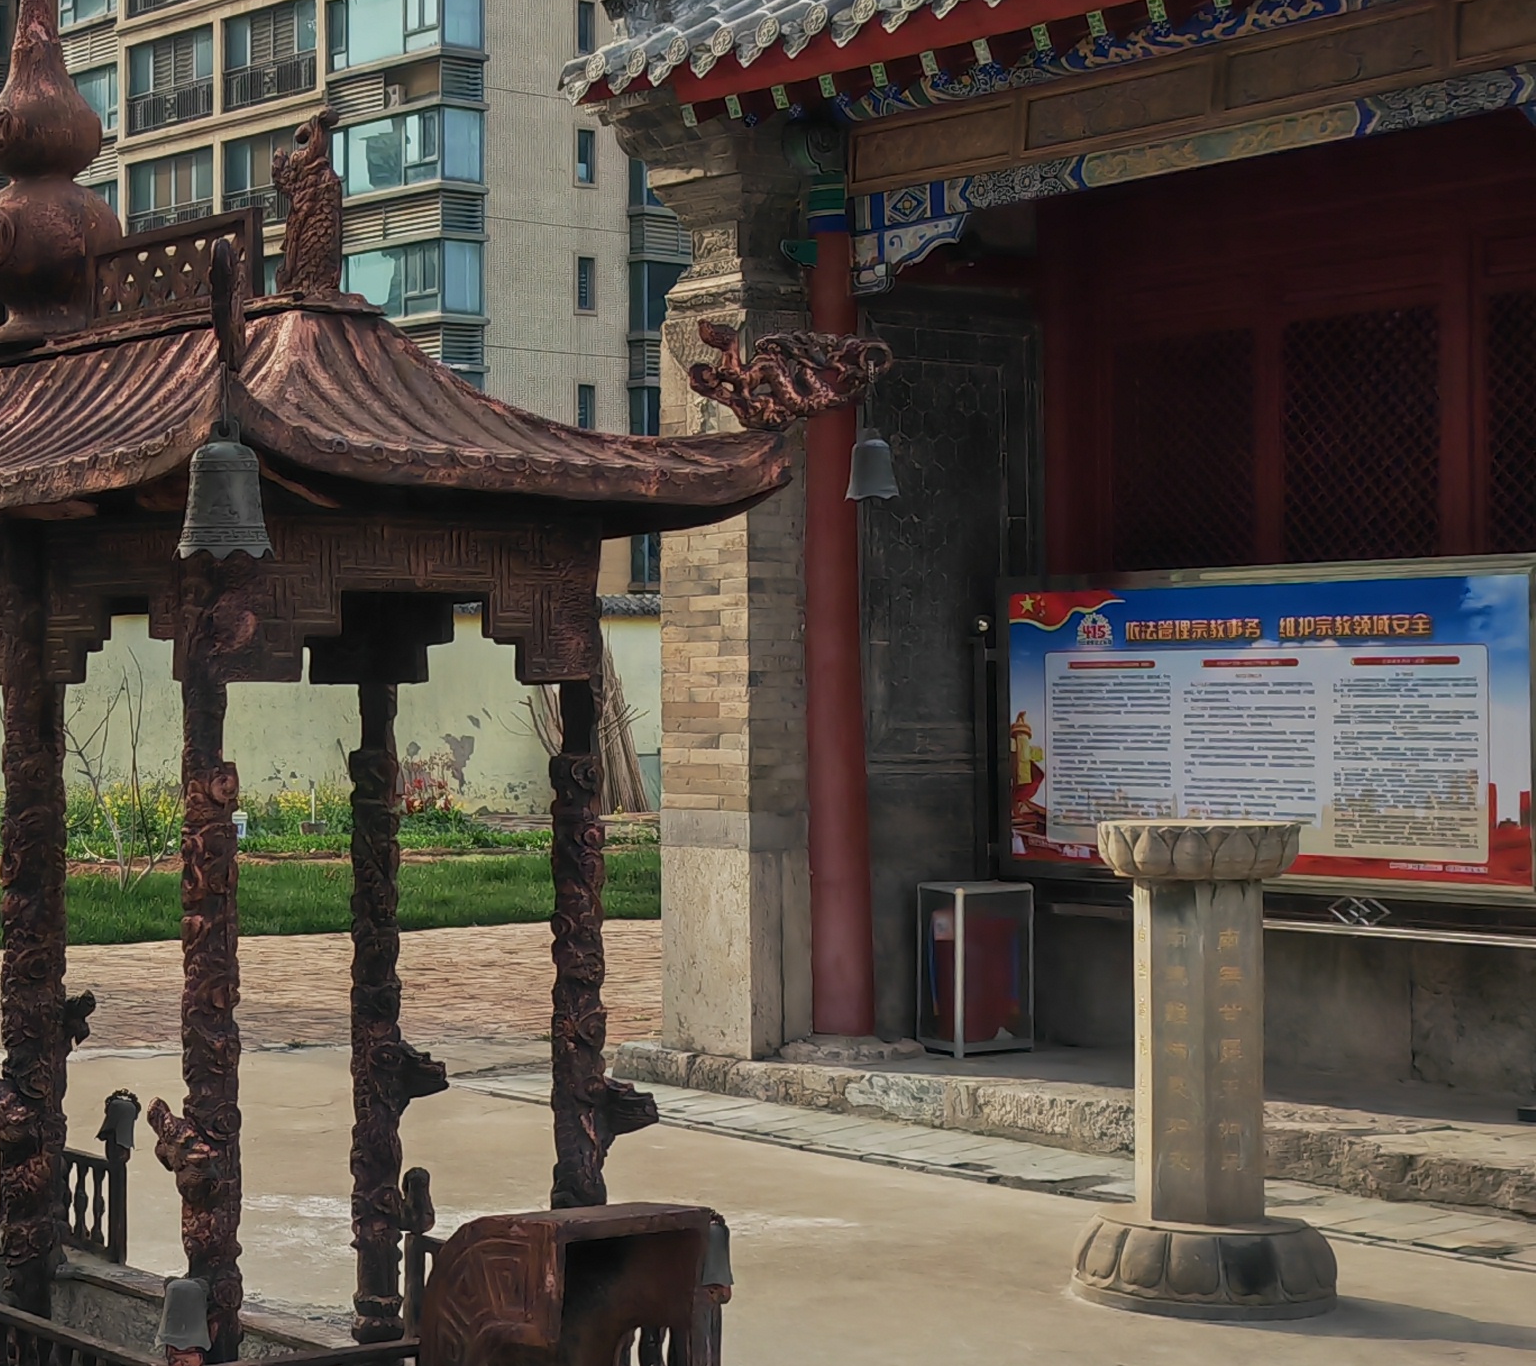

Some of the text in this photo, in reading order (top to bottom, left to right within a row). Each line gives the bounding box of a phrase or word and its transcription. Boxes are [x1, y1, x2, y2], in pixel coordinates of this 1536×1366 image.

[1125, 612, 1432, 641] 依法管理宗教事务 维护宗教领域安全
